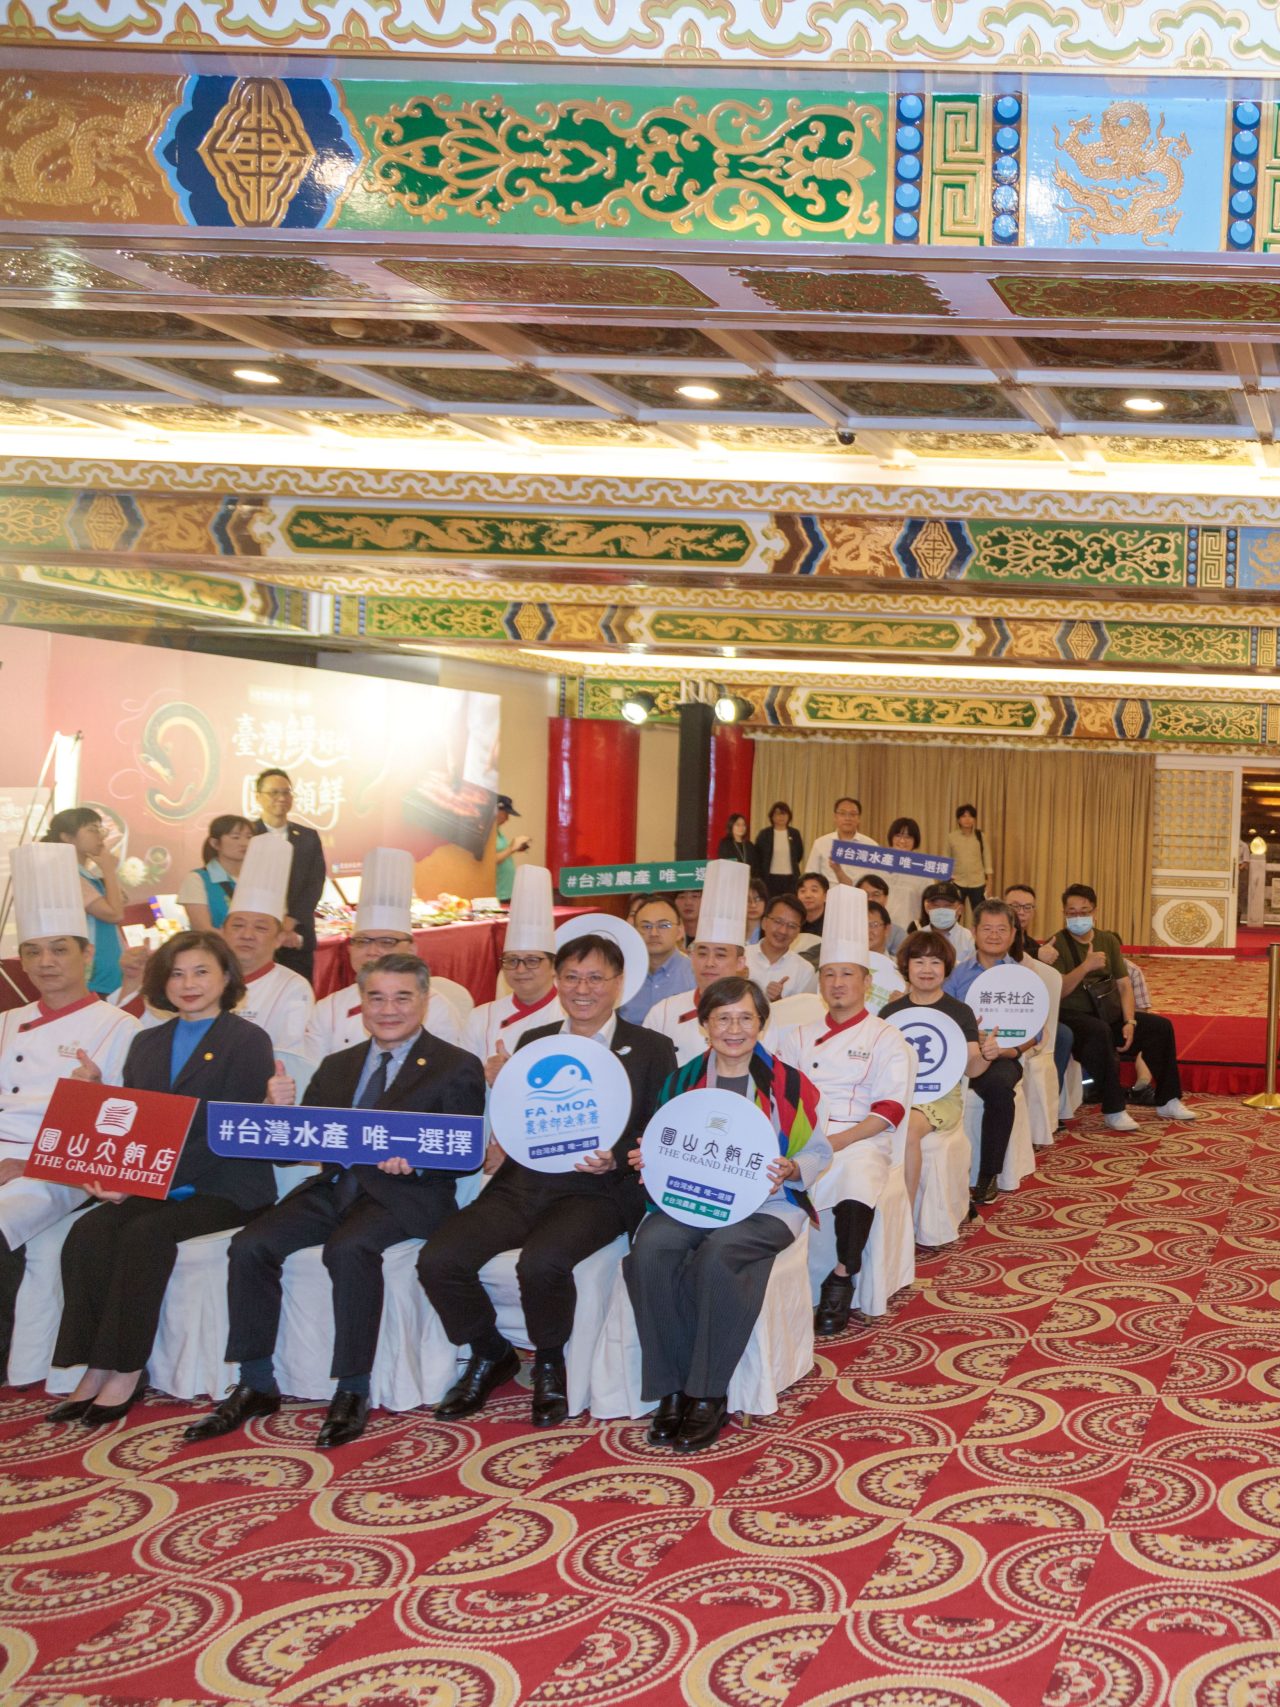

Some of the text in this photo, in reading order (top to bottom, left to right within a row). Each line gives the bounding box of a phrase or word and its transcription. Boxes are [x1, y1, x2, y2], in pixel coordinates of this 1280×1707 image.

[836, 846, 949, 874] #台灣水產 唯一選擇
[567, 870, 651, 888] #台灣農產
[38, 1127, 177, 1172] 圓山大飯店
[218, 1117, 473, 1157] #台灣水產 唯一選擇
[661, 1126, 765, 1171] 圓山大飯店
[34, 1153, 166, 1186] THE GRAND HOTEL
[658, 1145, 758, 1181] THE GRAND HOTEL
